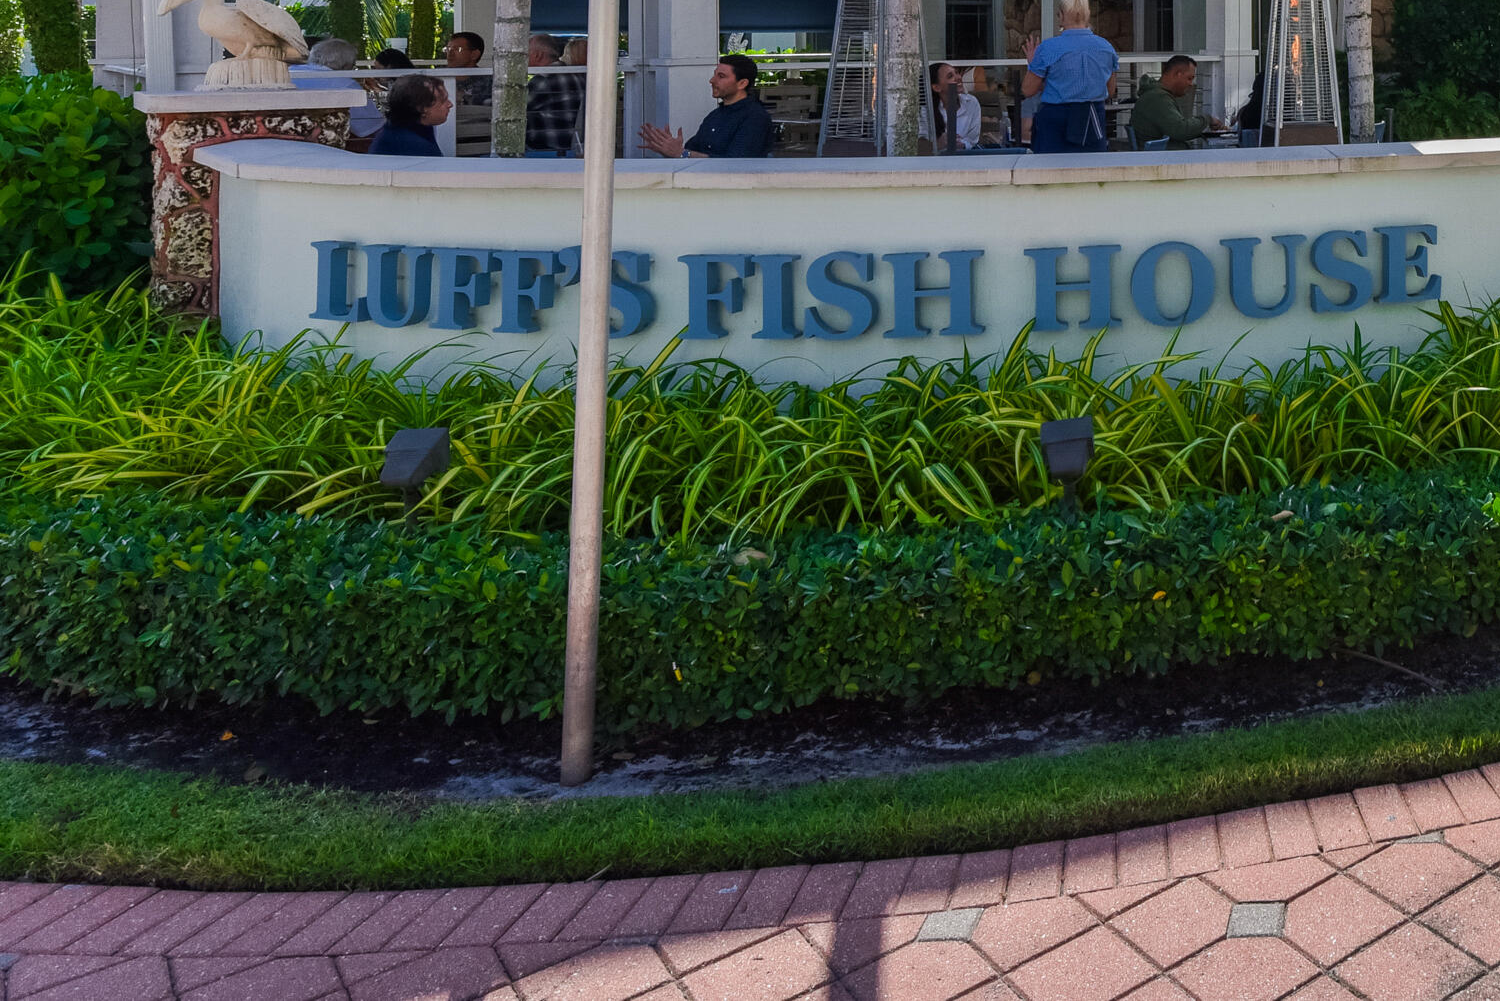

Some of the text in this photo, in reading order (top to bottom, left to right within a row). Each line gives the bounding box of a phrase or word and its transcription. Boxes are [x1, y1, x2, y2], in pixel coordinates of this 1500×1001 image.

[308, 223, 1443, 340] LUFF'S FISH HOUSE
